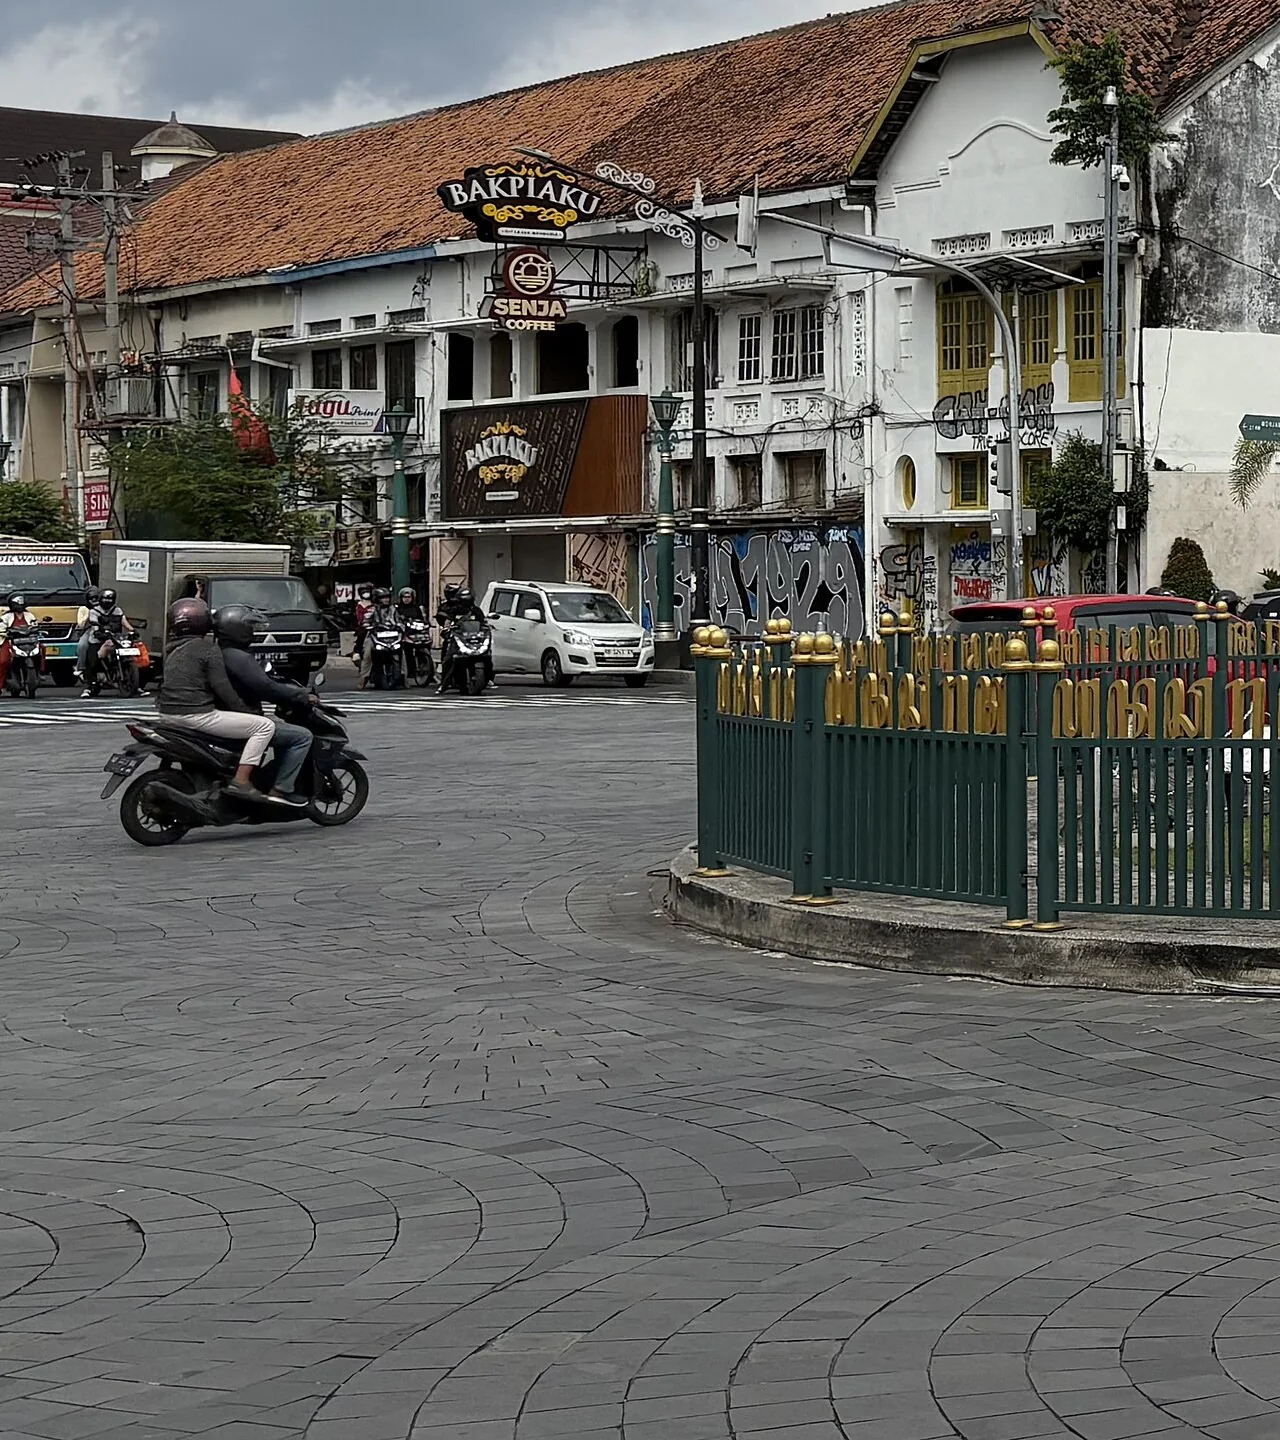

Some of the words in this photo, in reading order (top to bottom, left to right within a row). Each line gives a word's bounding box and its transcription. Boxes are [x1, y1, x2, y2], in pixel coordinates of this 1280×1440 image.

[446, 175, 601, 214] BAKPIAKU
[493, 298, 566, 317] SENJA
[505, 319, 556, 331] COFFEE
